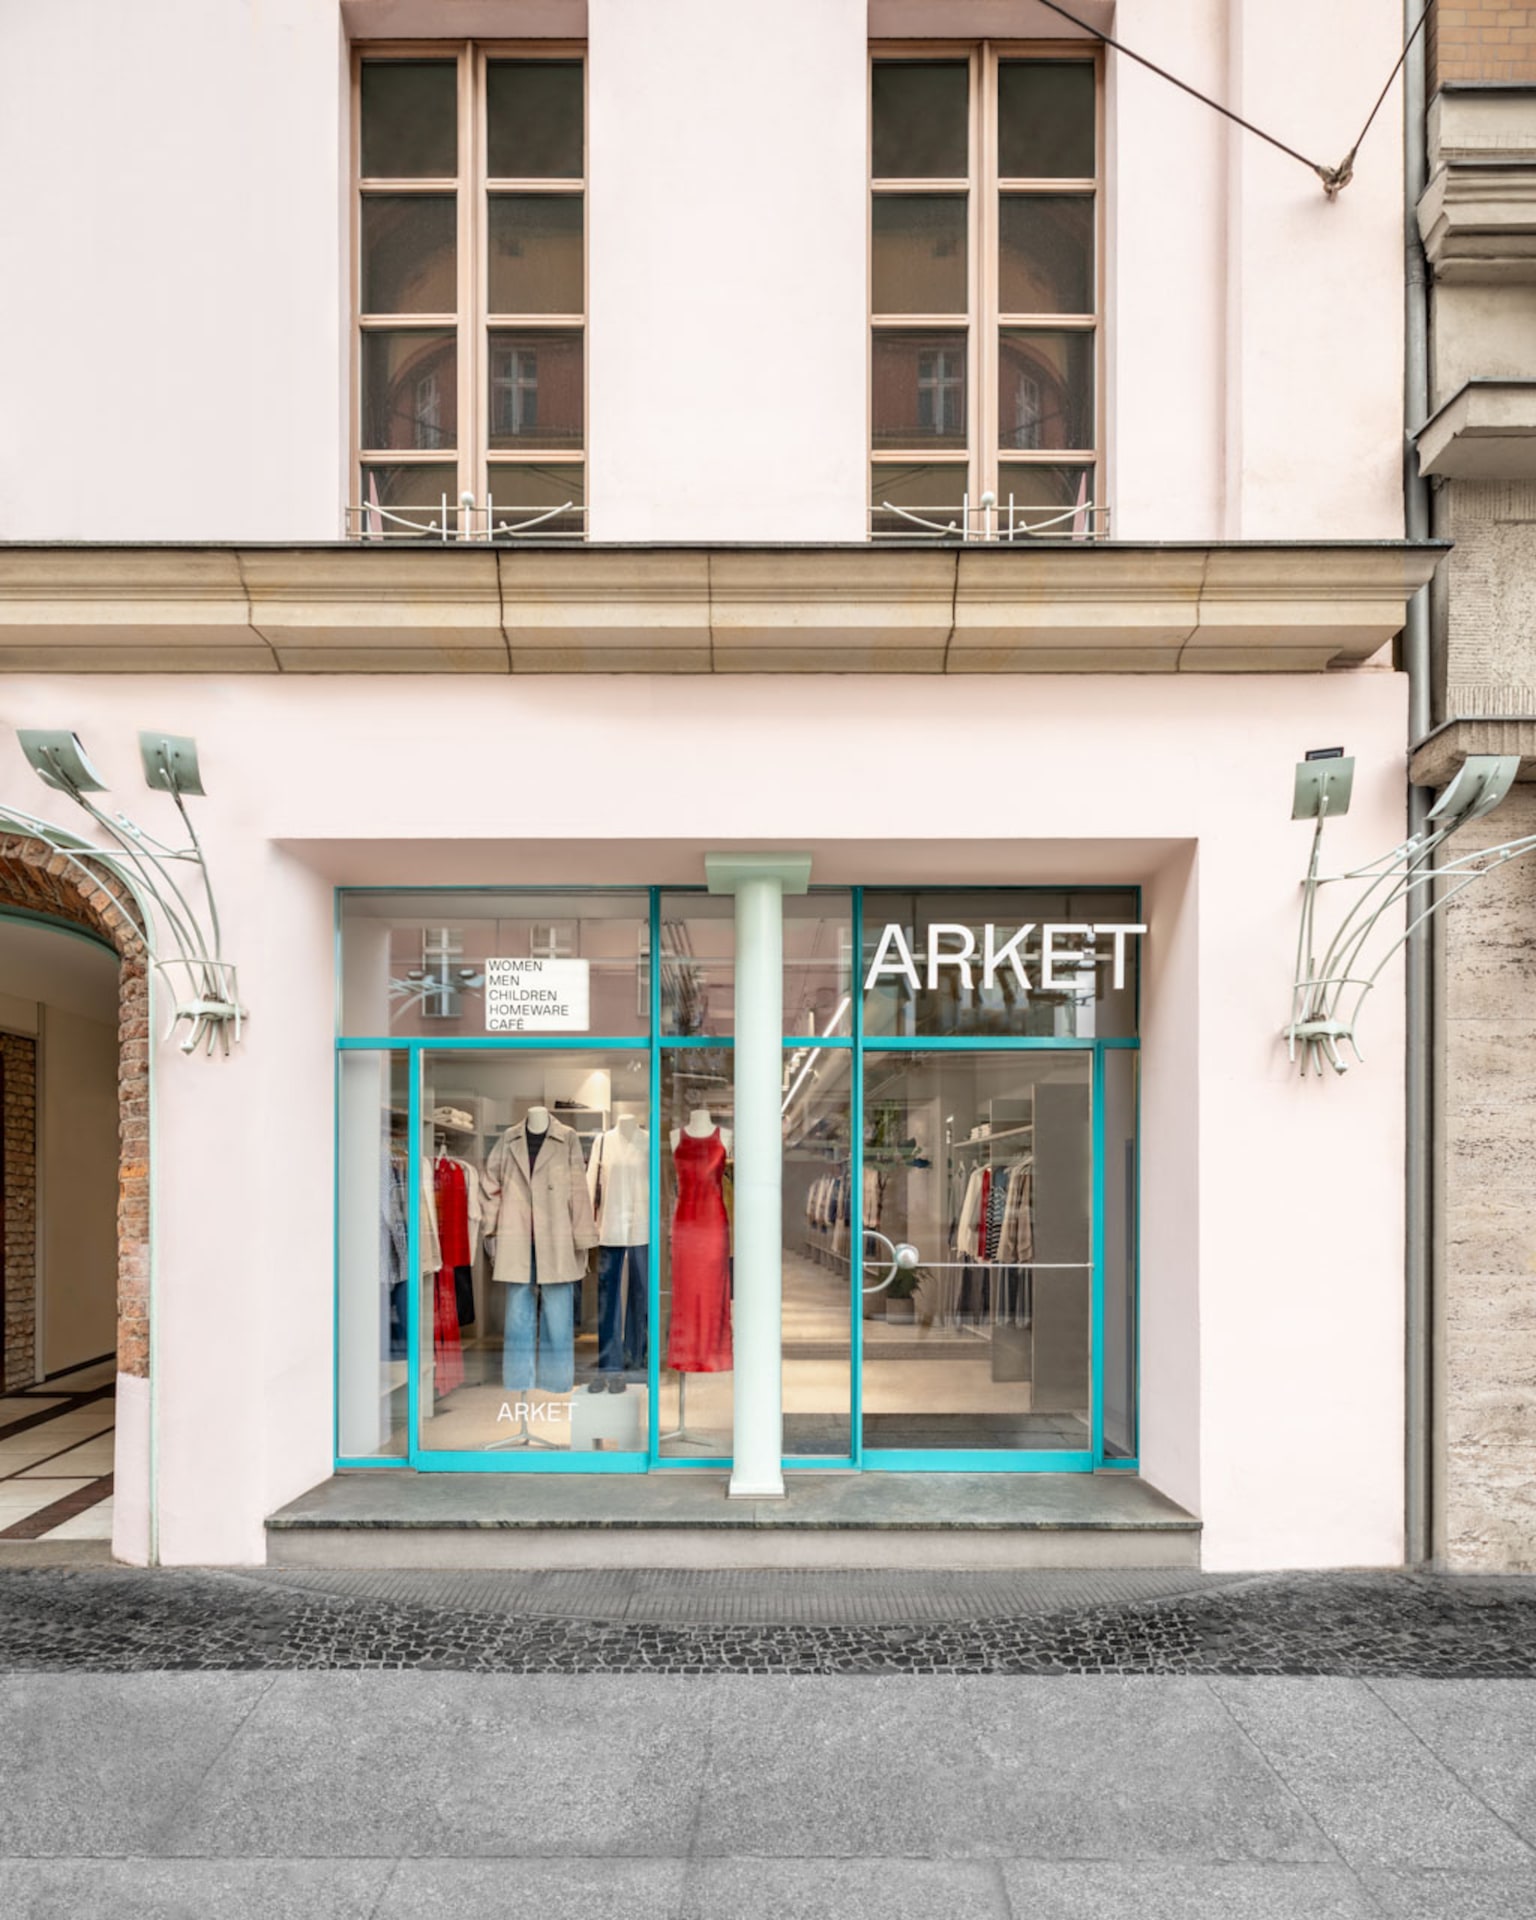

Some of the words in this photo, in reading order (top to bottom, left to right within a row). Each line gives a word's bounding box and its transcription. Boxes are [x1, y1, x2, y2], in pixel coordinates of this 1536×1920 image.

[864, 923, 1147, 990] ARKET
[488, 960, 543, 972] WOMEN
[489, 975, 520, 986] MEN
[488, 989, 558, 1001] CHILDREN
[489, 1004, 569, 1016] HOMEWARE
[489, 1017, 525, 1030] CAFÉ
[496, 1402, 579, 1422] ARKET
